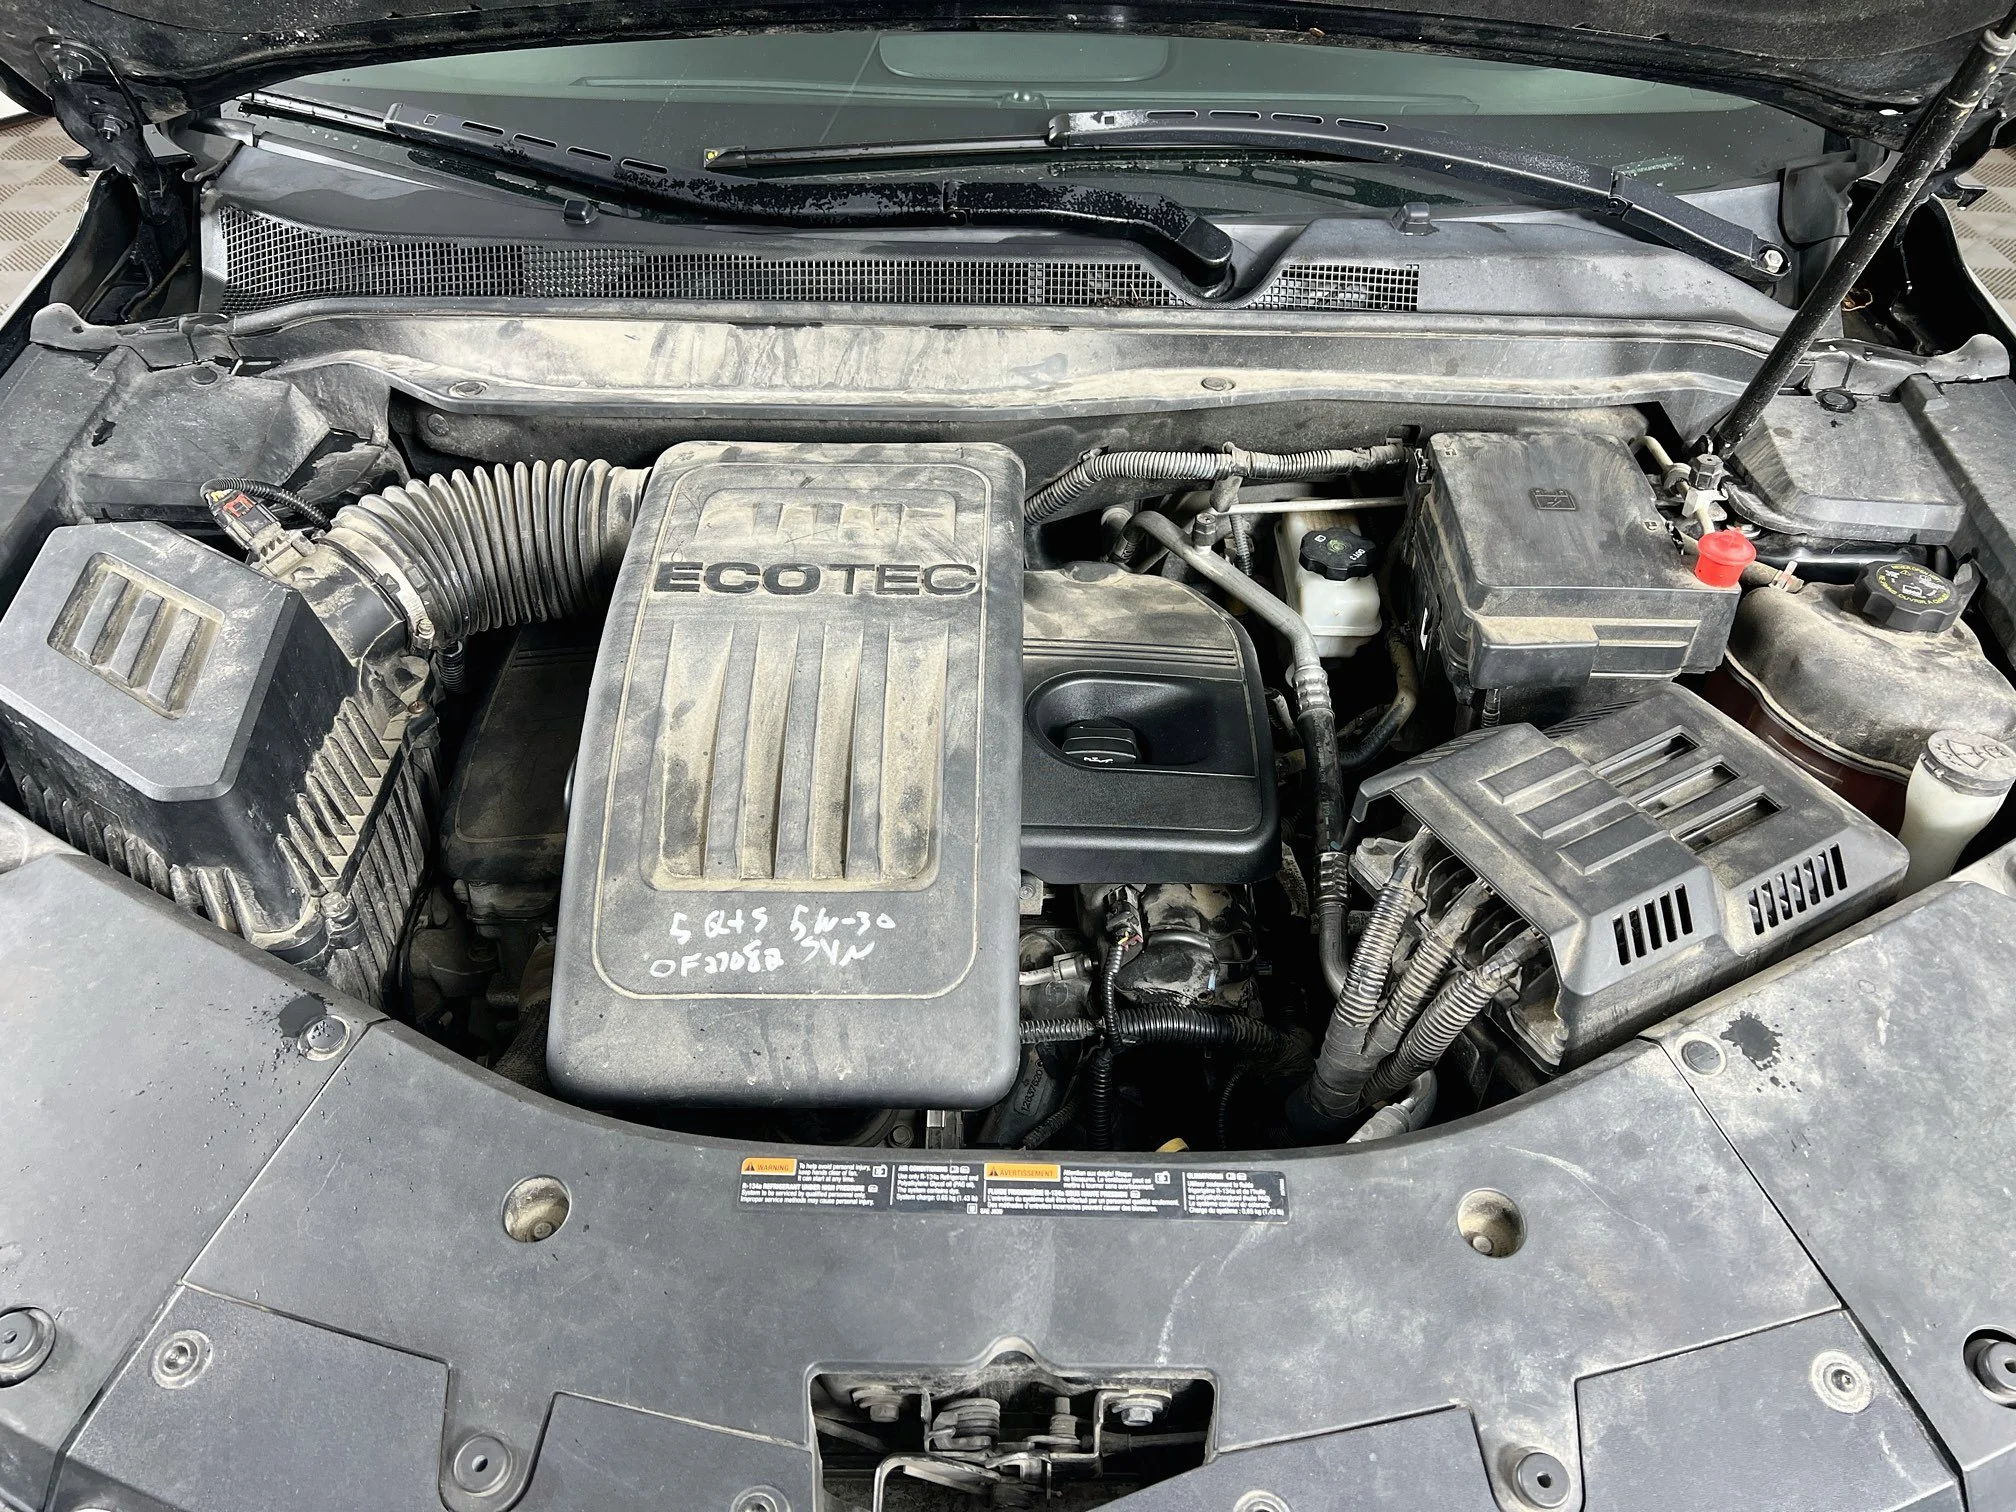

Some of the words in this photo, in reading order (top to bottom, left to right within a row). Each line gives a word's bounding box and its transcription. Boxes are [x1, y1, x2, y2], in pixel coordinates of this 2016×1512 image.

[653, 561, 977, 595] ECOTEC
[757, 1164, 789, 1172] WARNING
[999, 1169, 1054, 1177] AVERTISSEMENT
